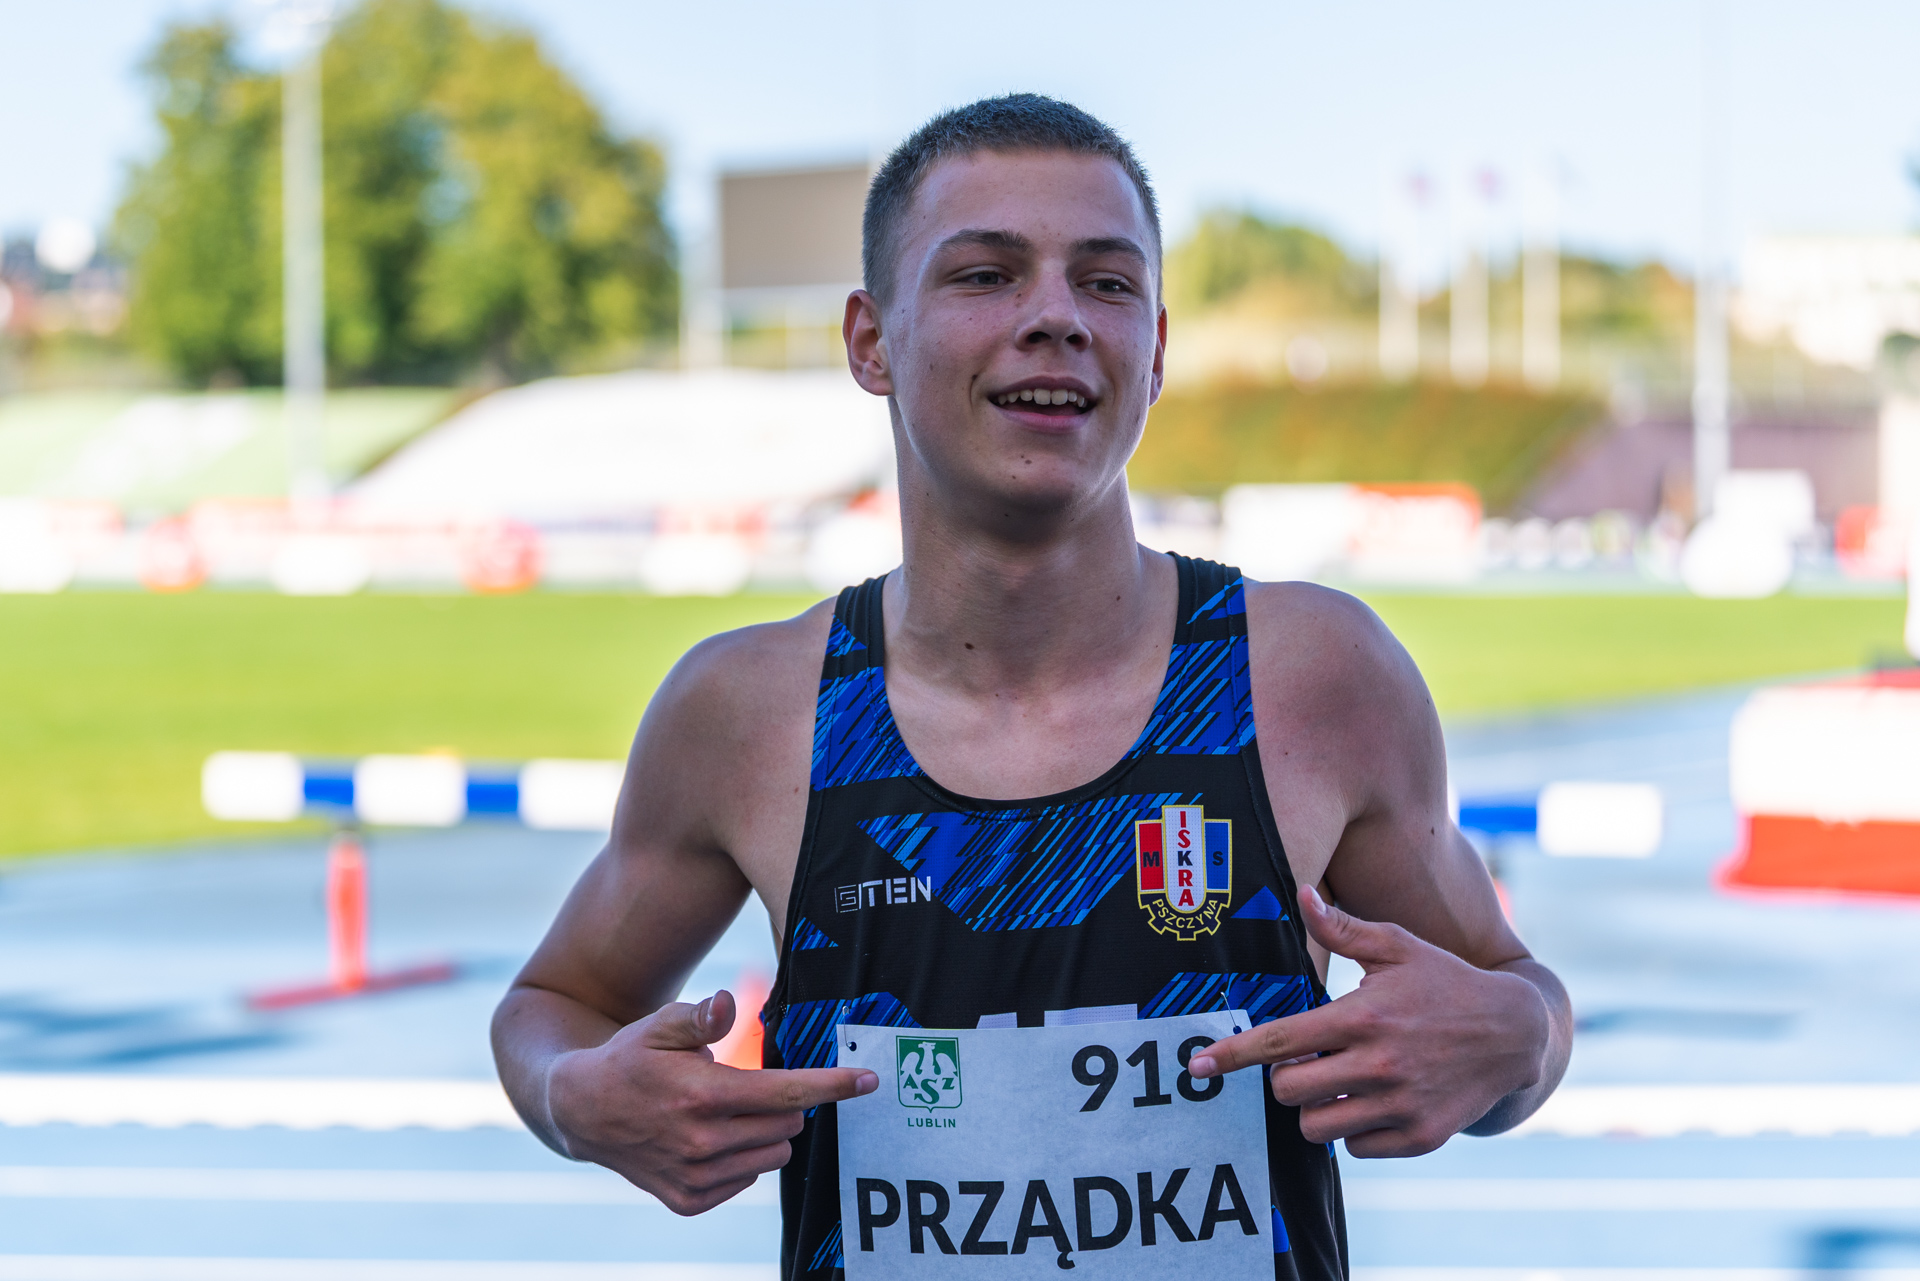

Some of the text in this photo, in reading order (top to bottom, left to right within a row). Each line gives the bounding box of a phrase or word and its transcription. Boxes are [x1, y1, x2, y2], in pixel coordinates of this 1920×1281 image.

[1142, 851, 1160, 867] M
[1178, 811, 1194, 906] ISKRA
[1212, 851, 1224, 866] S
[1152, 898, 1218, 929] PSZCZYNA
[1071, 1036, 1224, 1112] 918
[907, 1117, 956, 1128] LUBLIN
[856, 1163, 1259, 1270] PRZĄDKA
